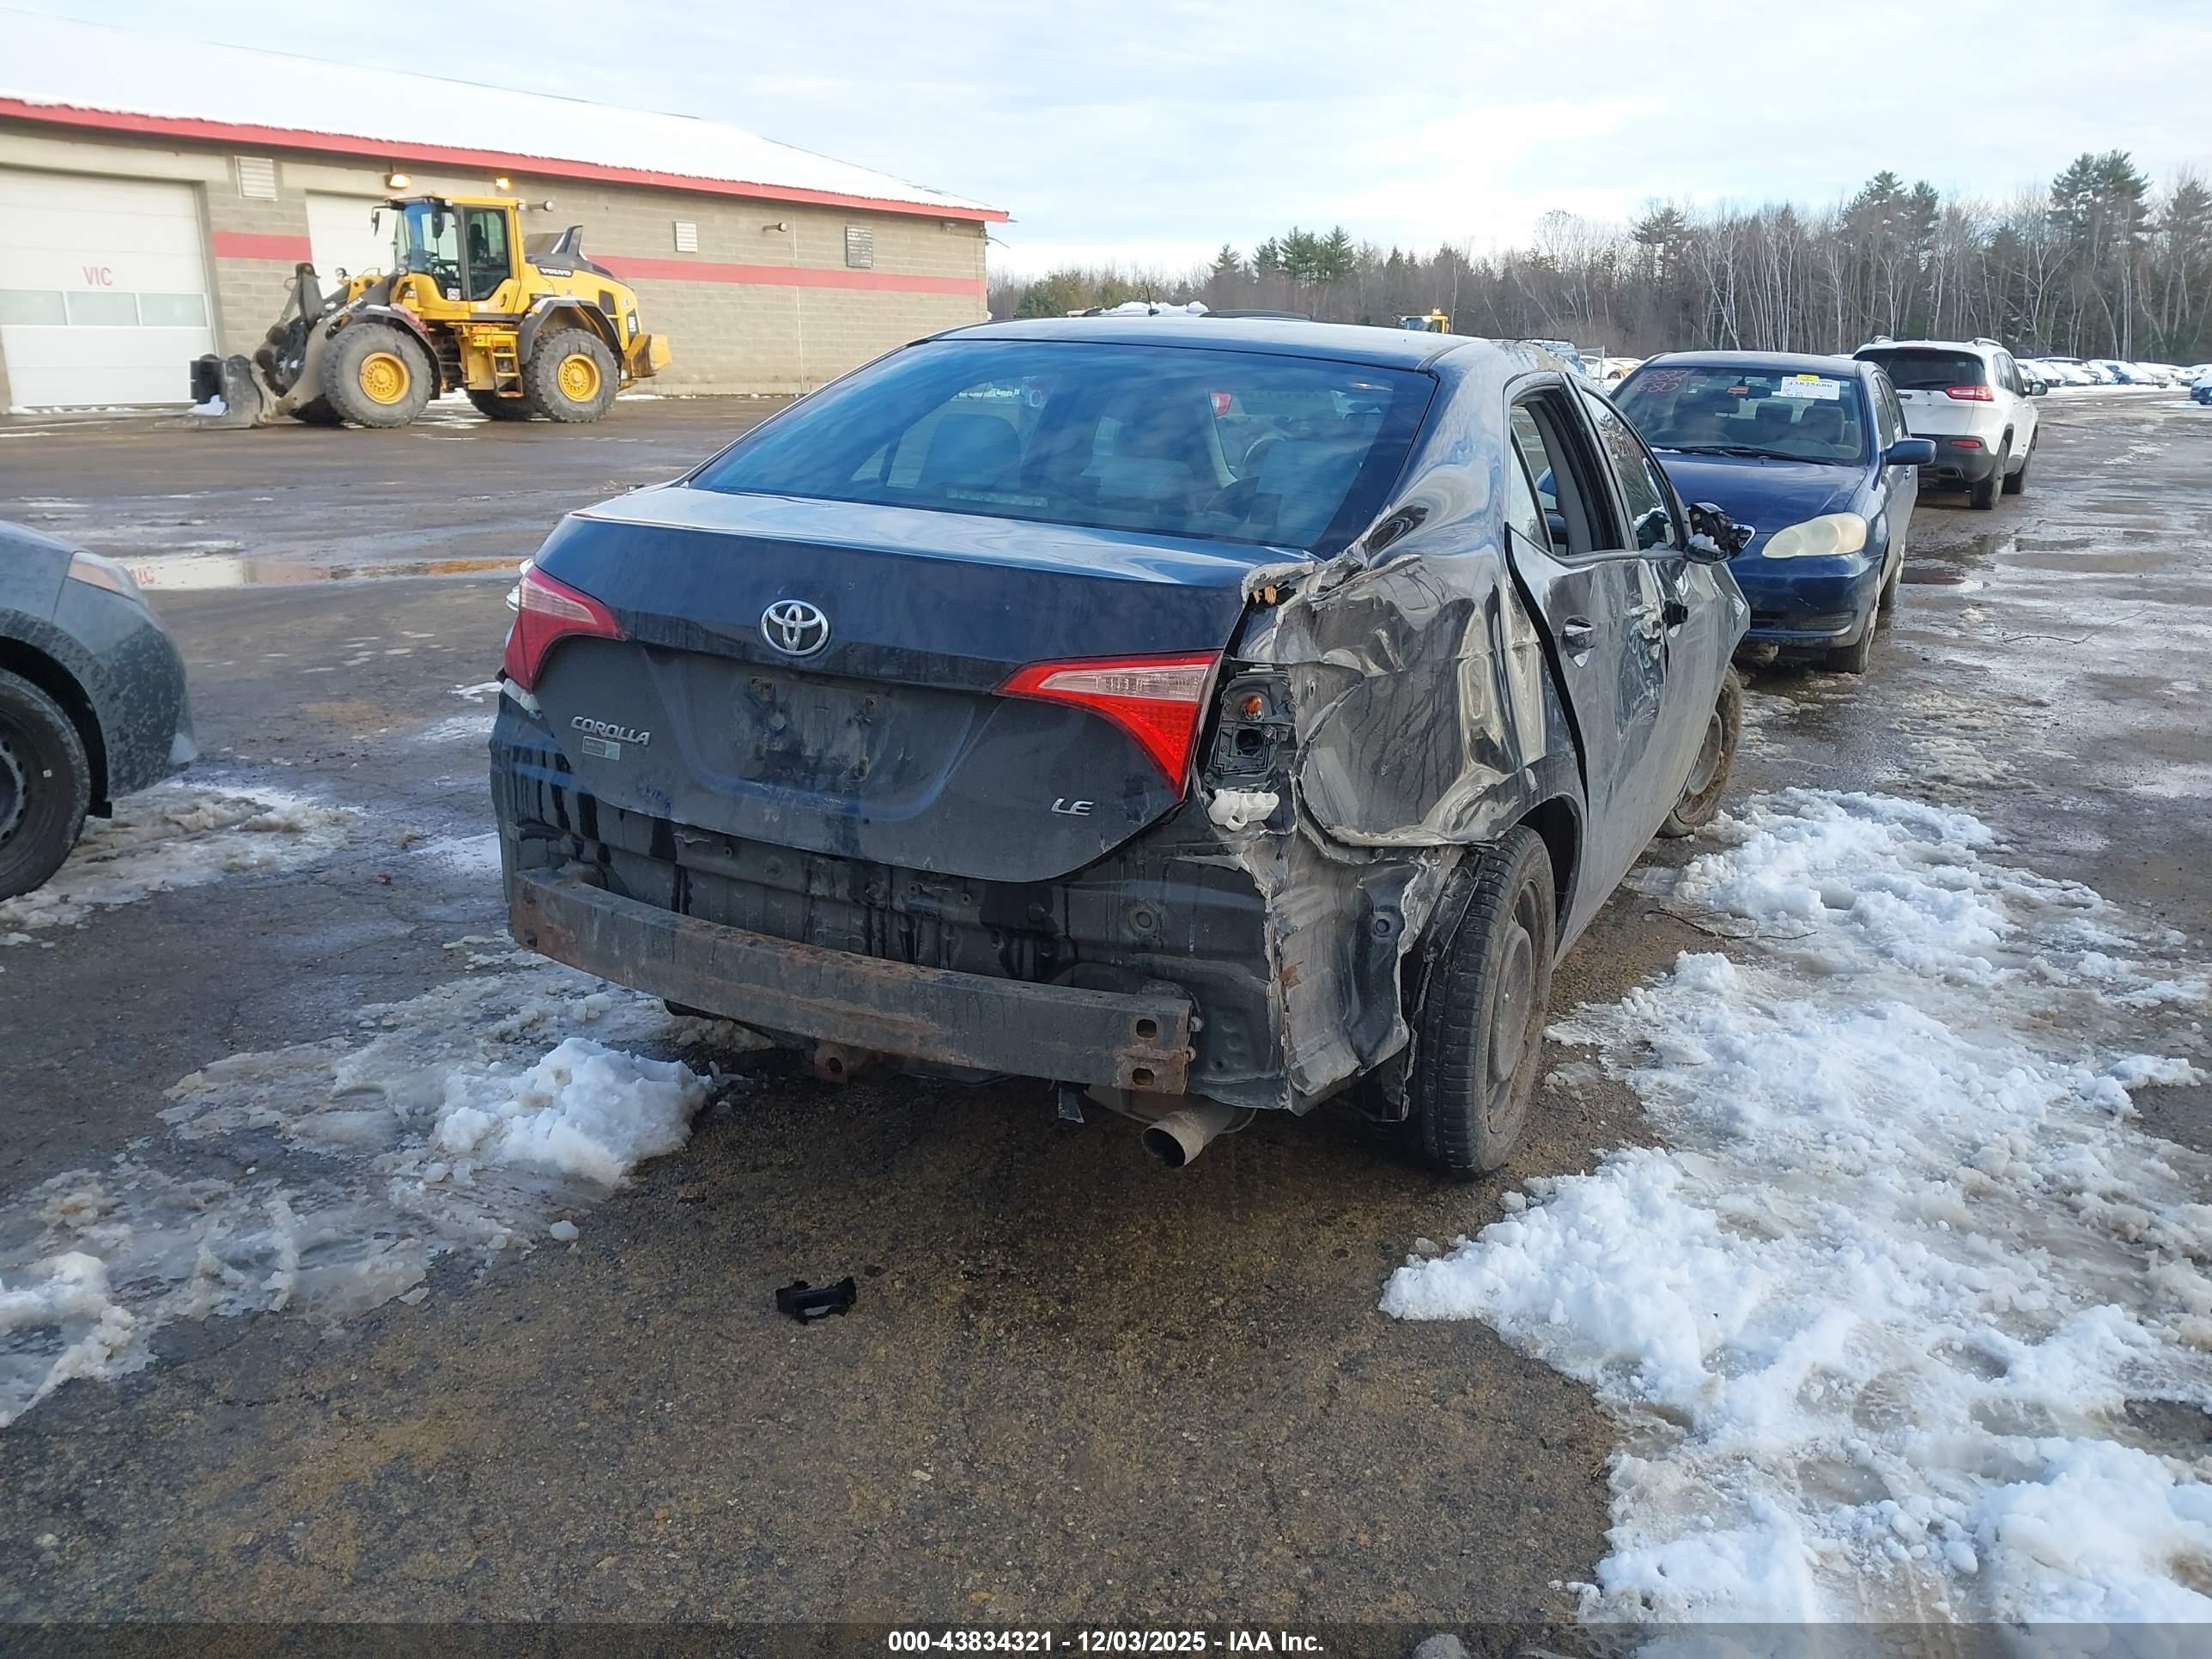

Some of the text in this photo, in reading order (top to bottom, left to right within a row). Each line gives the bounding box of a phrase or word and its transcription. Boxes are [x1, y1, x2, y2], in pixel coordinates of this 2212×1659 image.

[82, 266, 112, 286] VIC
[539, 268, 573, 276] VOLVO
[570, 715, 652, 746] COROLLA
[1050, 798, 1095, 816] LE
